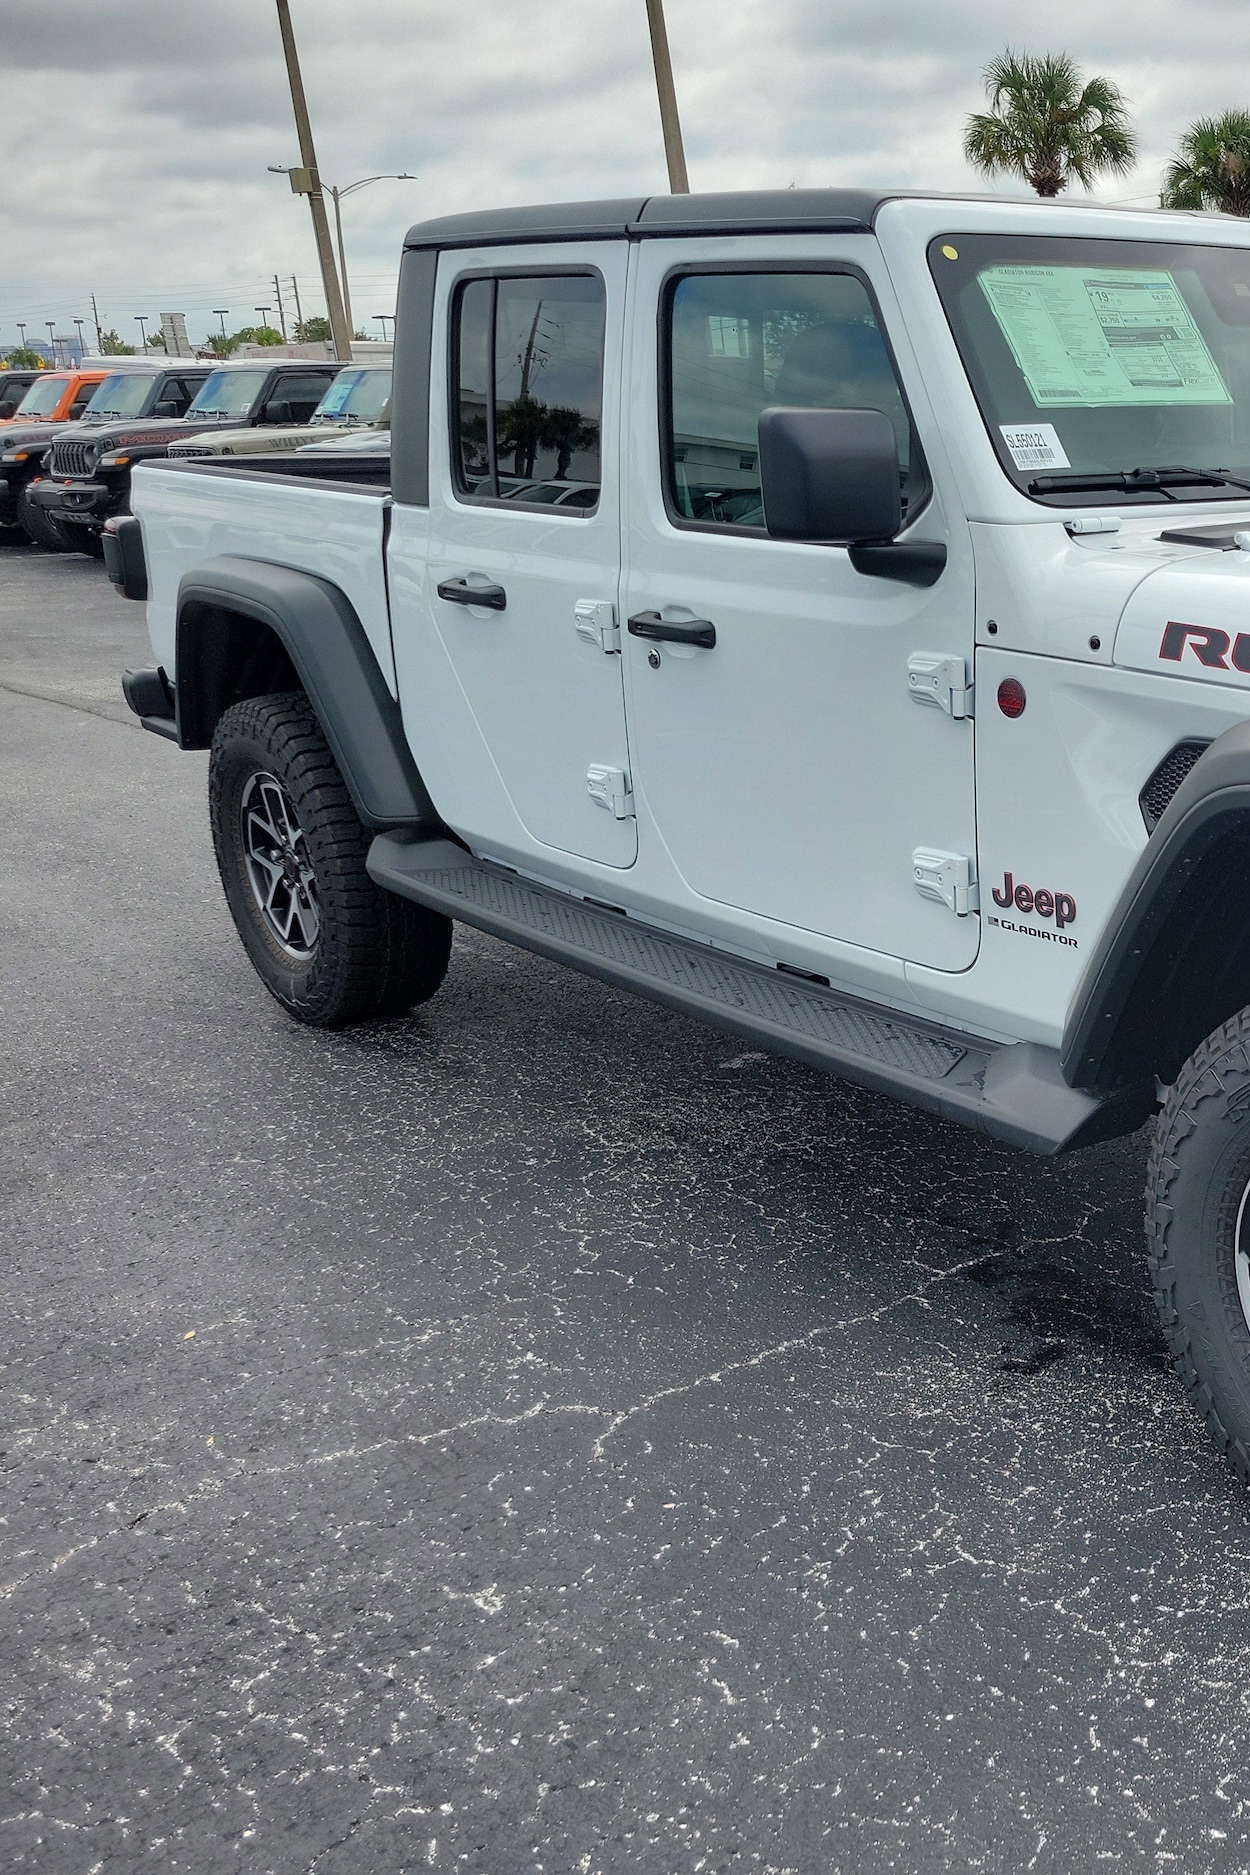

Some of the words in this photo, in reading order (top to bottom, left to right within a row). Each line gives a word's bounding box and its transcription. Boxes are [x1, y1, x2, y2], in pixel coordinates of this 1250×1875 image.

[1096, 291, 1109, 302] 19
[1005, 433, 1048, 448] SL550121
[991, 871, 1077, 929] Jeep
[1001, 919, 1079, 949] GLADIATOR
